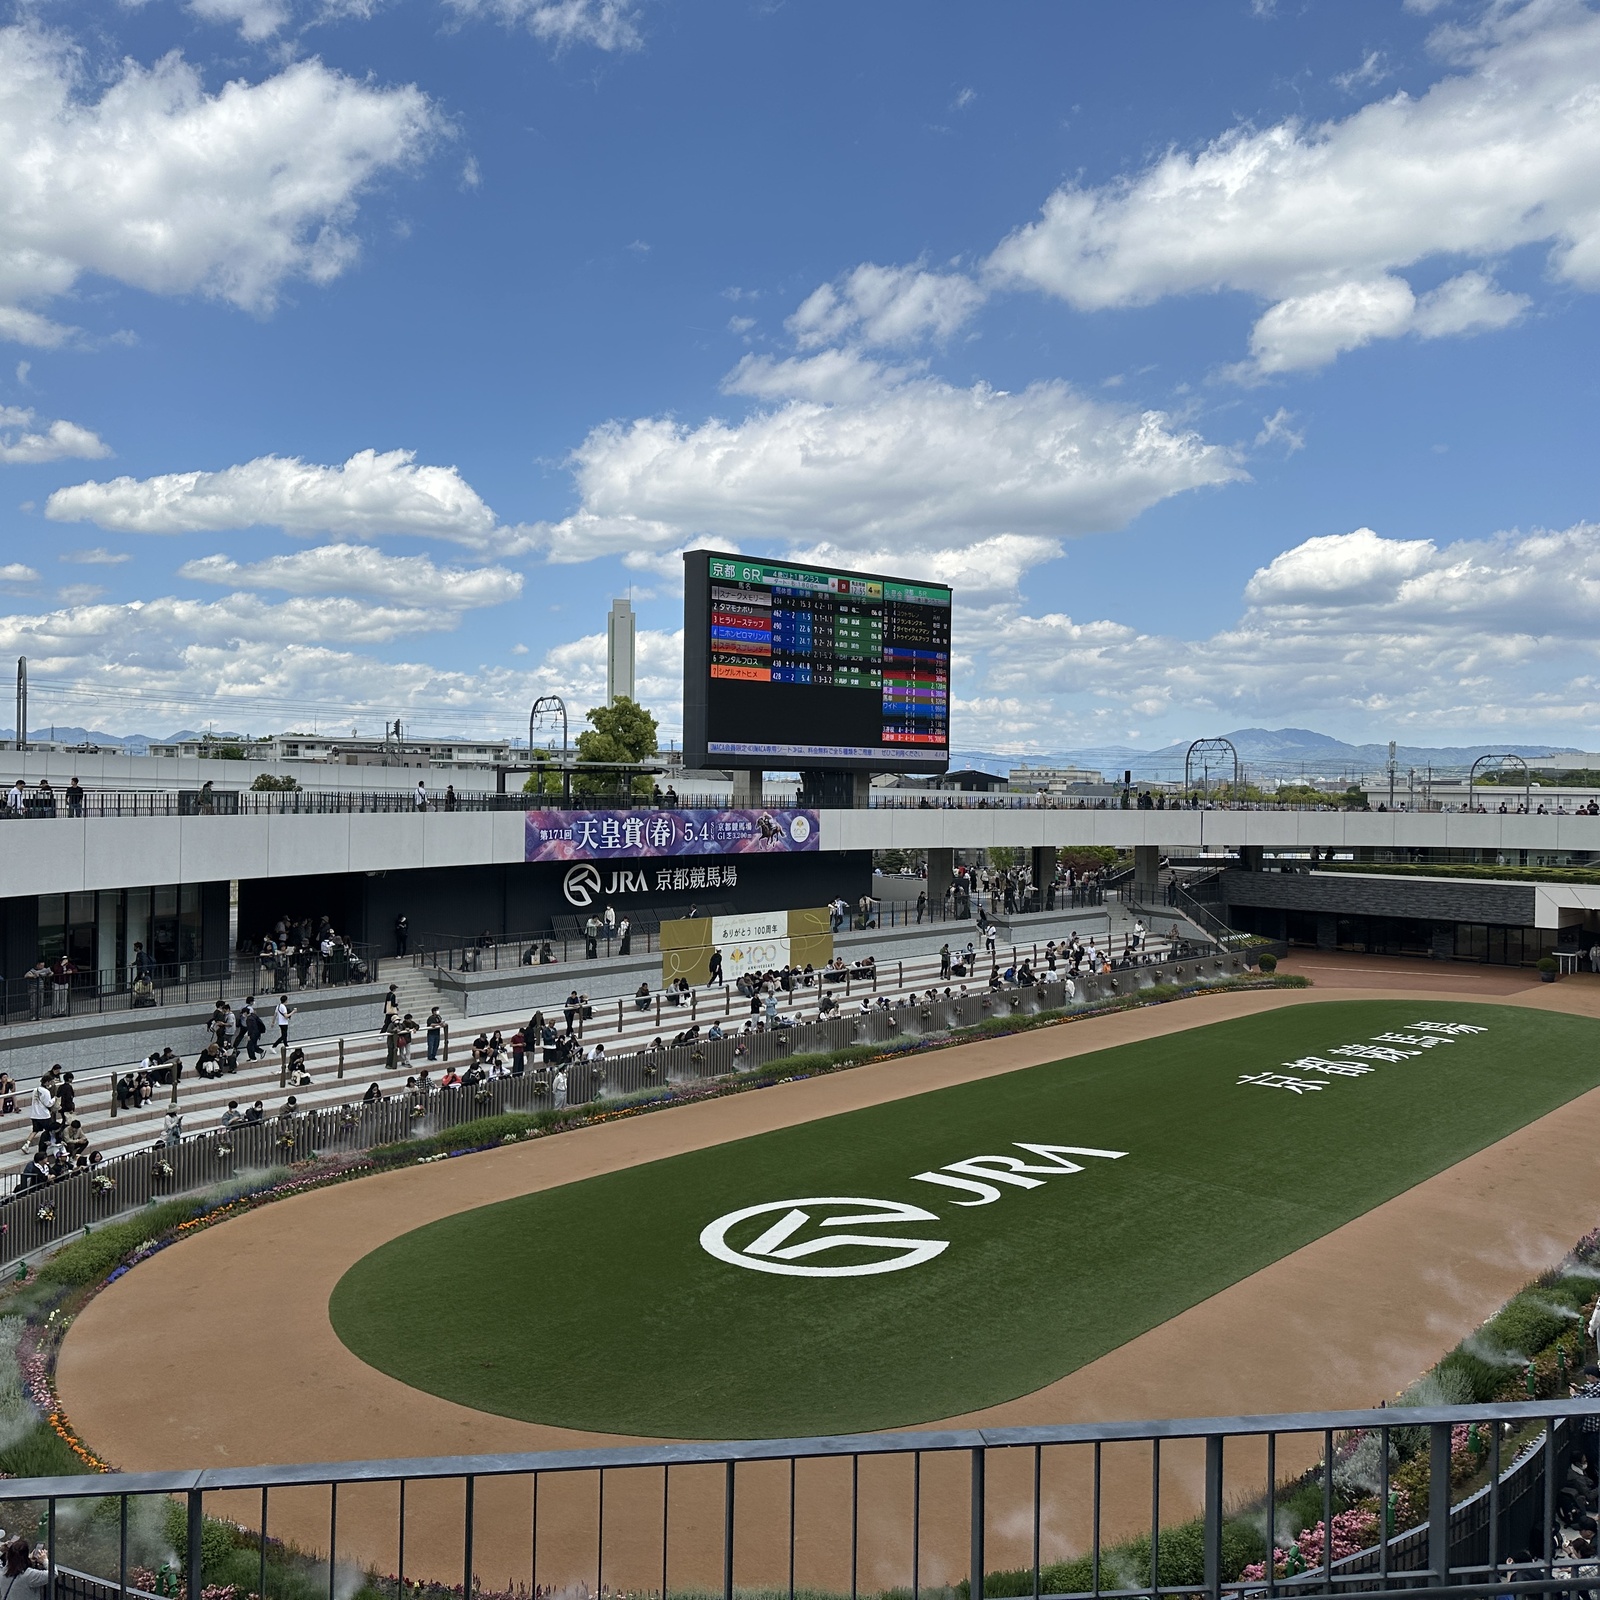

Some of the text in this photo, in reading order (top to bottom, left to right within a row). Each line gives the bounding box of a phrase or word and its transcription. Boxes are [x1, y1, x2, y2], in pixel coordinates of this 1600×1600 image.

[712, 562, 760, 581] 京都 6R
[774, 597, 782, 605] 434
[800, 600, 811, 609] 15.3
[719, 616, 764, 628] ヒラリーステップ
[772, 622, 782, 630] 490
[802, 612, 811, 621] 1.5
[772, 672, 782, 680] 428
[801, 674, 810, 682] 5.4
[883, 702, 898, 710] ワイド
[540, 829, 572, 841] 第171回
[684, 822, 709, 842] 5.4
[718, 822, 752, 832] 京都競馬場
[605, 865, 738, 894] JRA 京都競馬場
[722, 925, 778, 938] ありがとう 100周年
[746, 944, 776, 964] 100
[1236, 1021, 1488, 1094] 京都競馬場
[908, 1142, 1130, 1206] JRA
